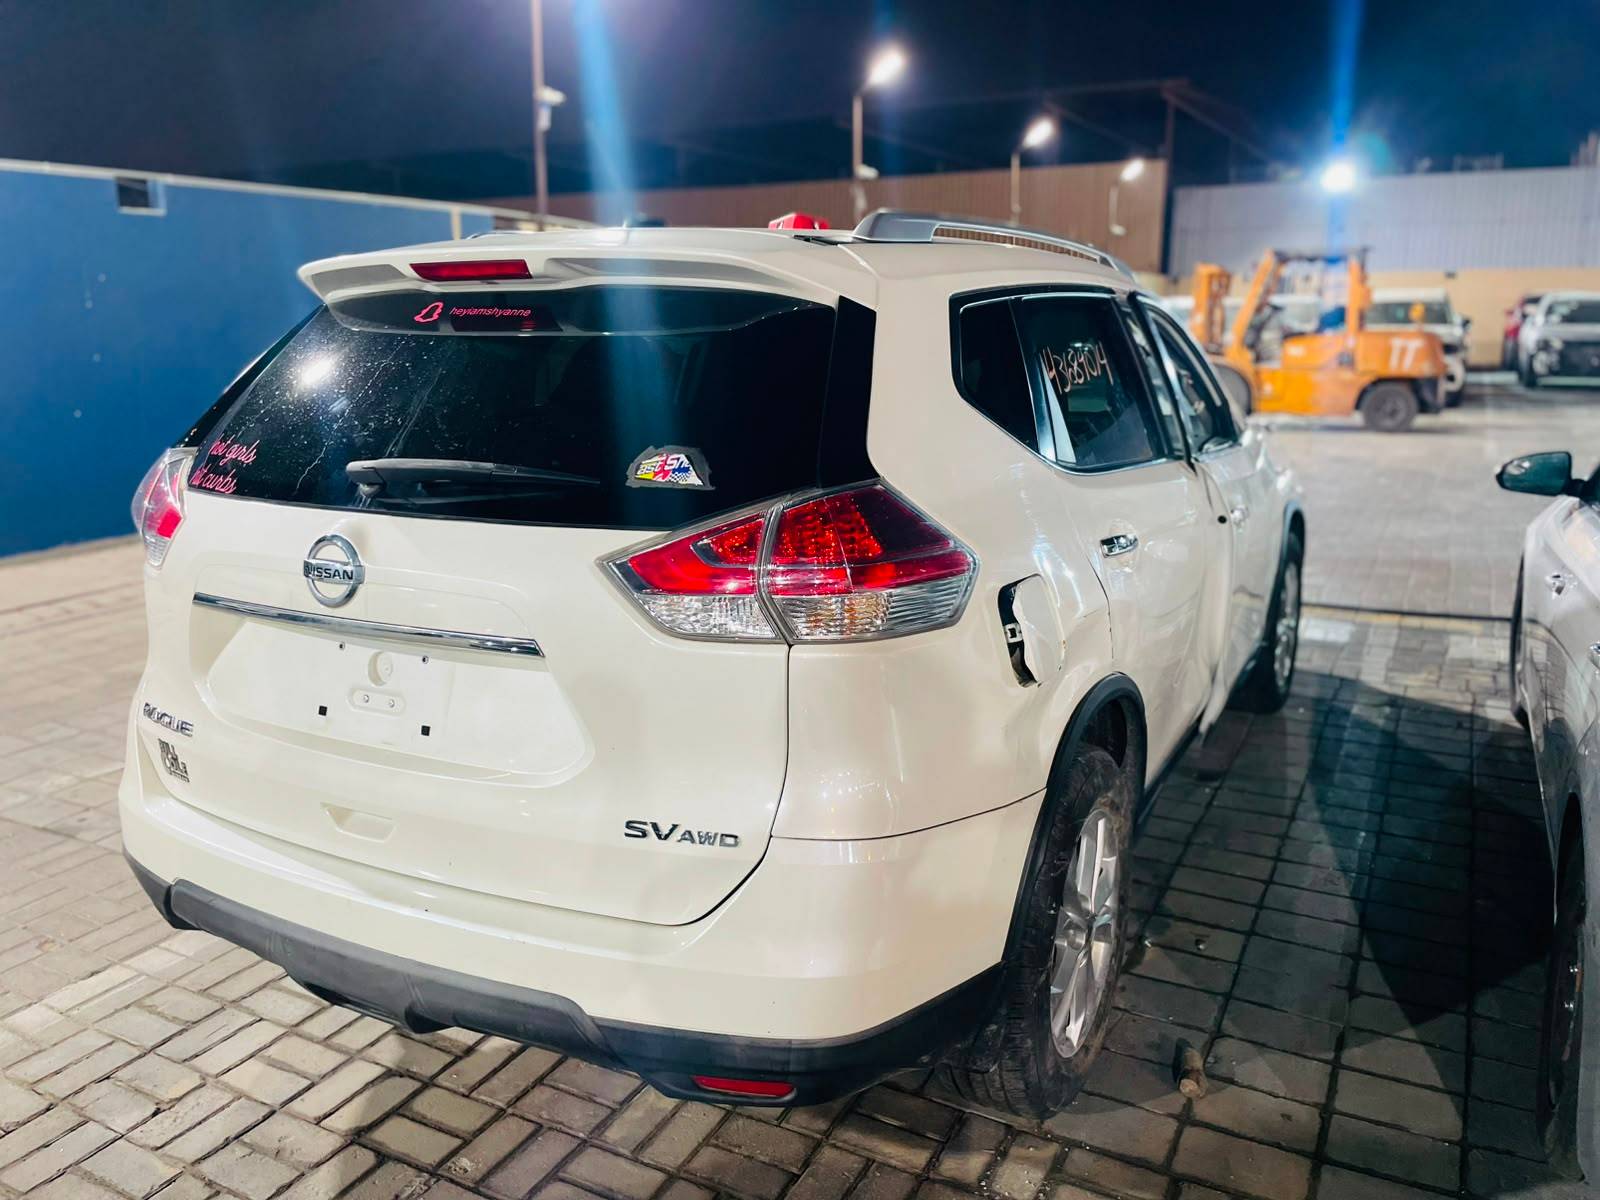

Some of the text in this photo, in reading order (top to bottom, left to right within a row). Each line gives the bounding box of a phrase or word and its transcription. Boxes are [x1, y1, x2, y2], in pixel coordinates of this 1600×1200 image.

[449, 307, 532, 317] heyiamshyanne
[219, 439, 260, 466] girls
[202, 468, 237, 494] curbs
[304, 564, 354, 580] NISSAN
[143, 702, 193, 737] ROGUE
[624, 820, 740, 847] SV AWD
